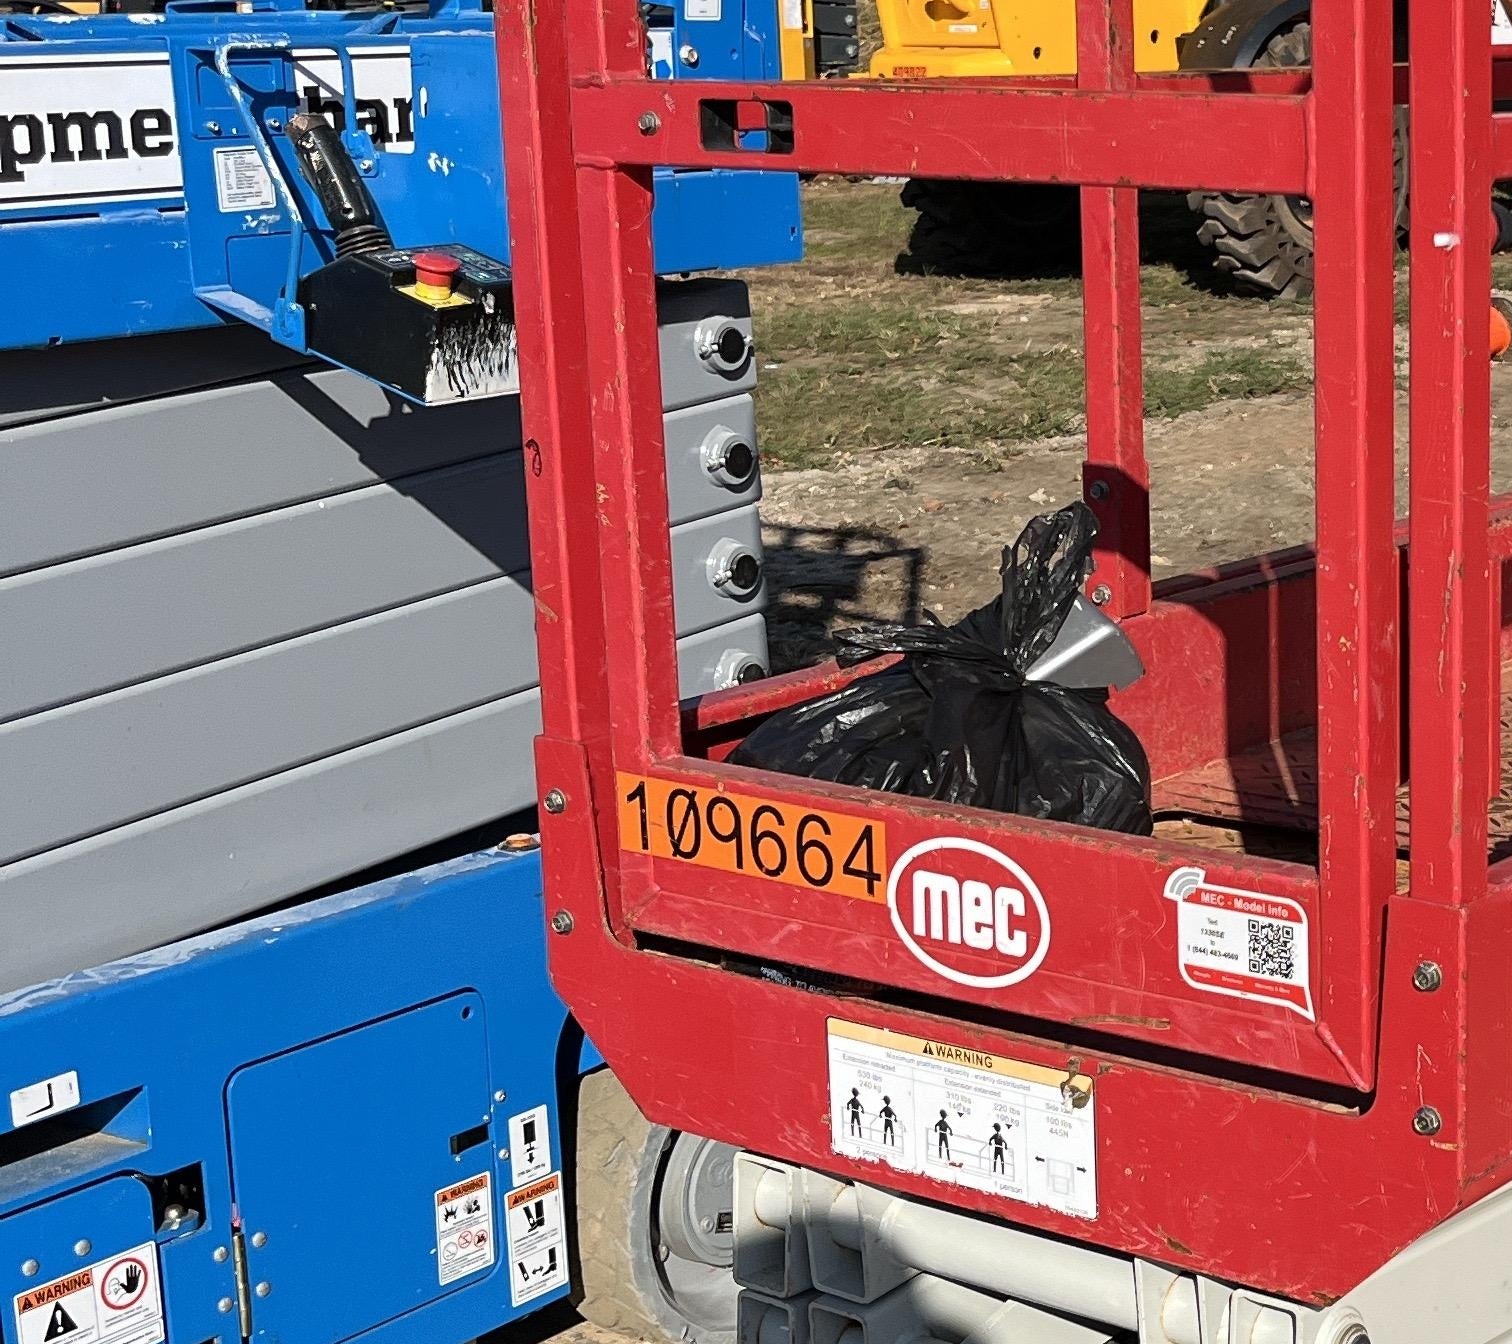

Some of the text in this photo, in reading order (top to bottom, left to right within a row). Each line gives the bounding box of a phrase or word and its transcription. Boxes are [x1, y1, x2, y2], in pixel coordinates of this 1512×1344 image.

[626, 780, 882, 897] 109664
[1200, 892, 1225, 906] MEC
[1234, 898, 1266, 914] Model
[935, 1043, 993, 1069] WARNING
[34, 1273, 92, 1304] WARNING
